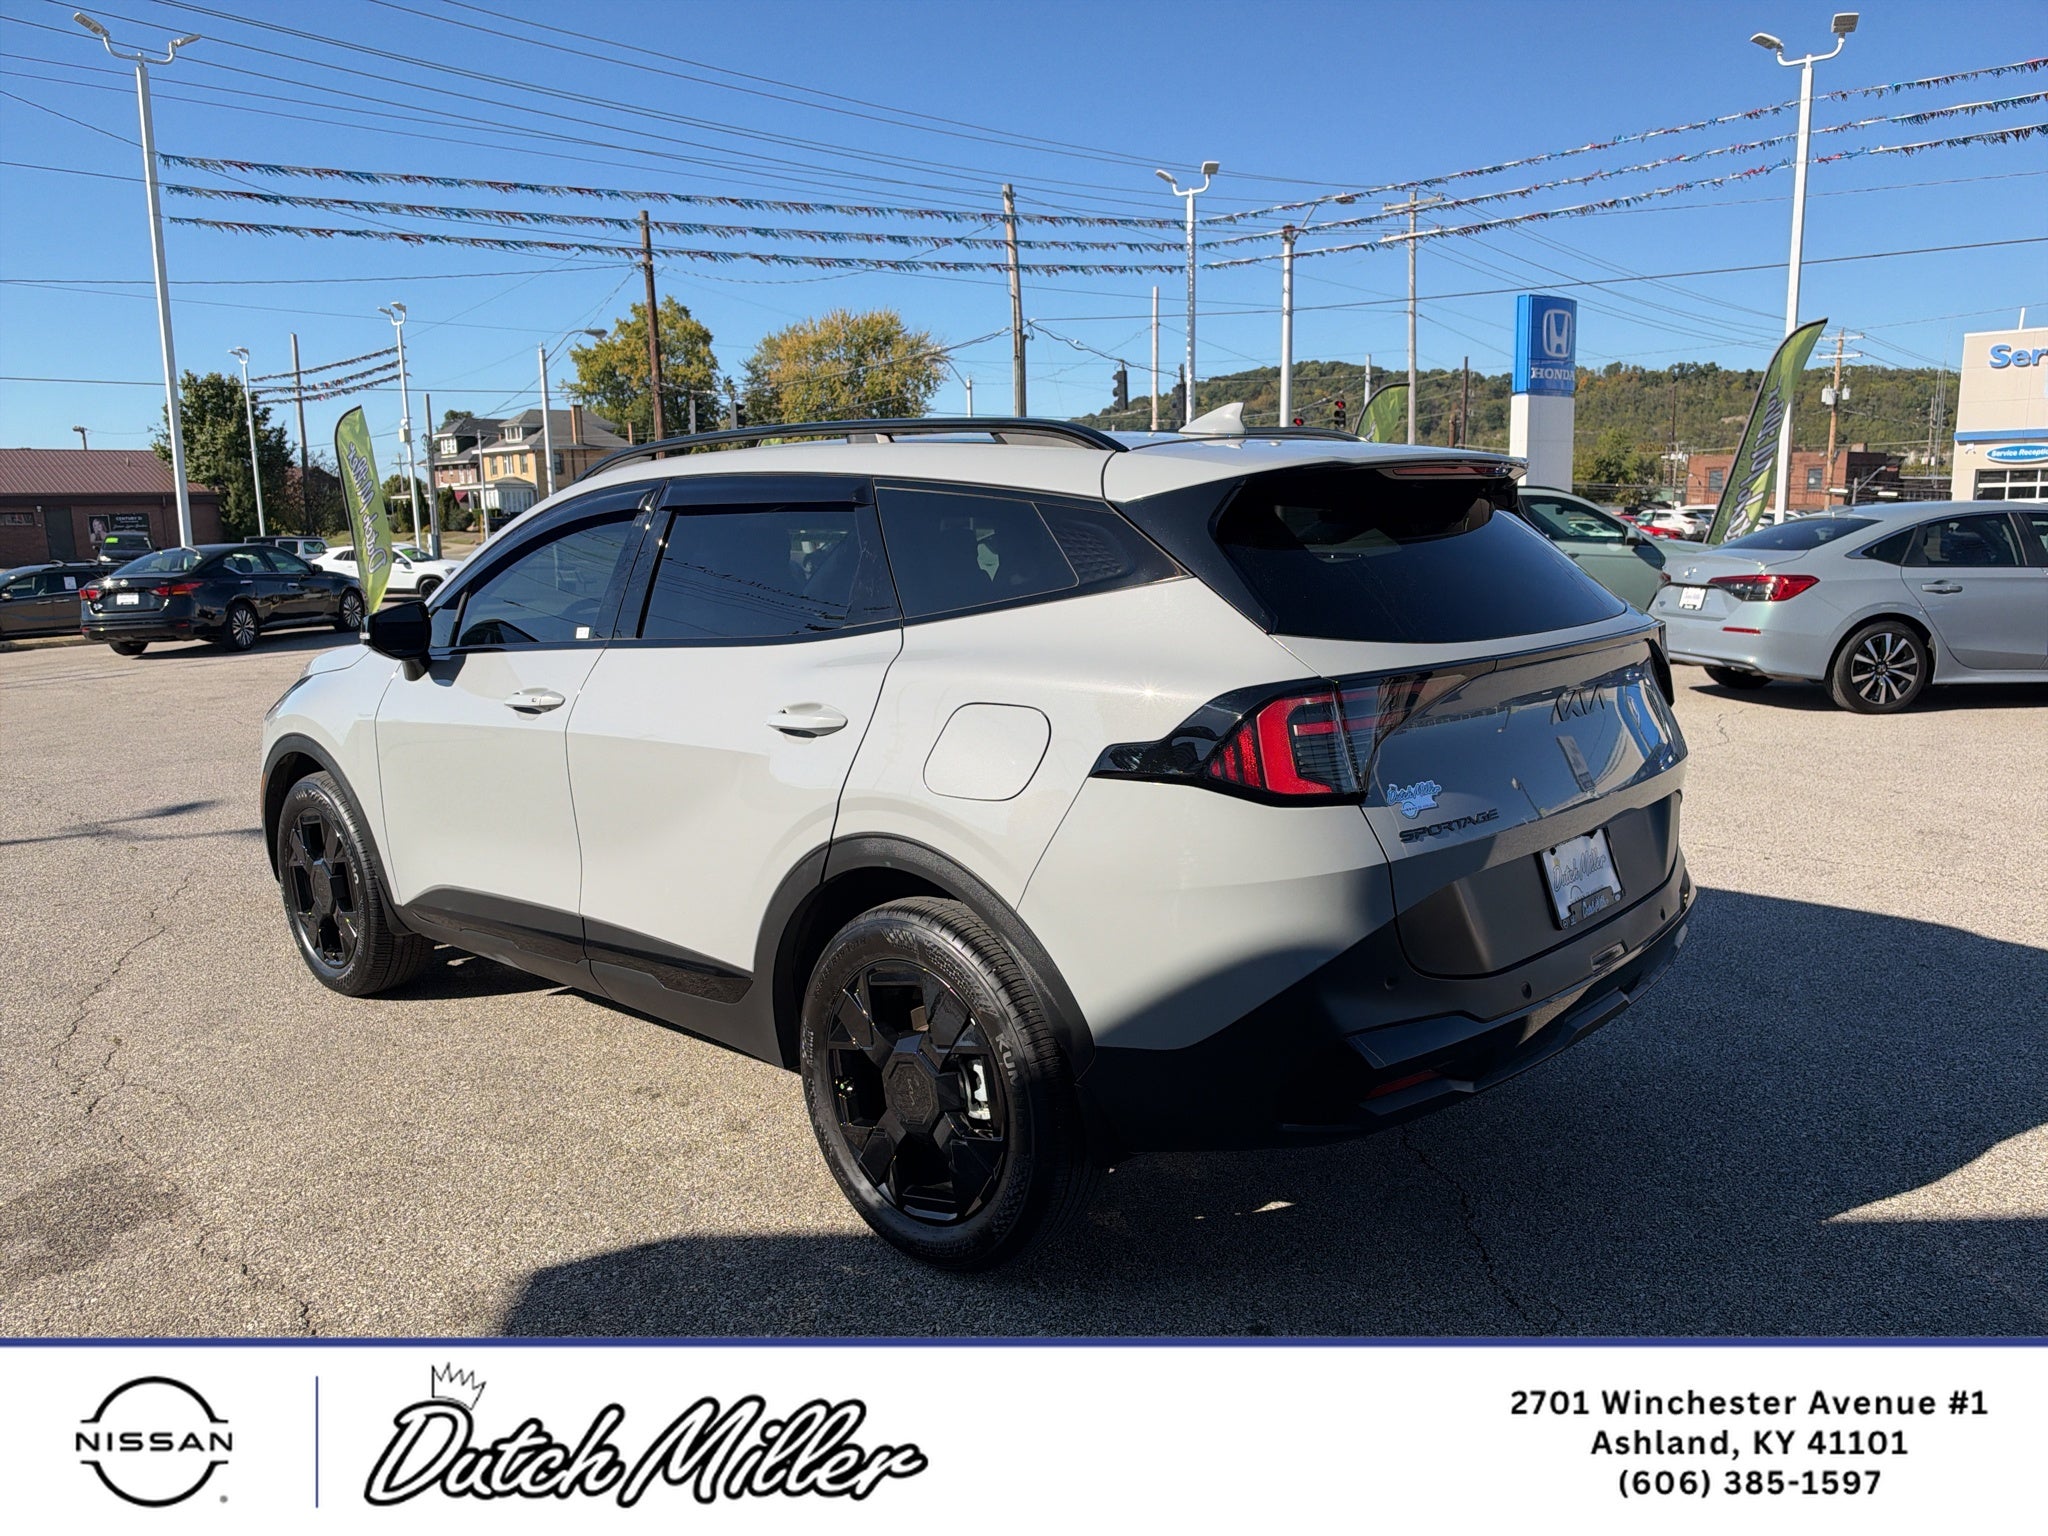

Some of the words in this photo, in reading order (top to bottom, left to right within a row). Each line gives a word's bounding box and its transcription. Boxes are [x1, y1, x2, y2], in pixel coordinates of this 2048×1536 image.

[1531, 367, 1574, 380] HONDA
[1991, 449, 2018, 457] Service
[1399, 808, 1499, 843] SPORTAGE
[1553, 858, 1583, 893] Dutch
[1579, 846, 1607, 877] Miller
